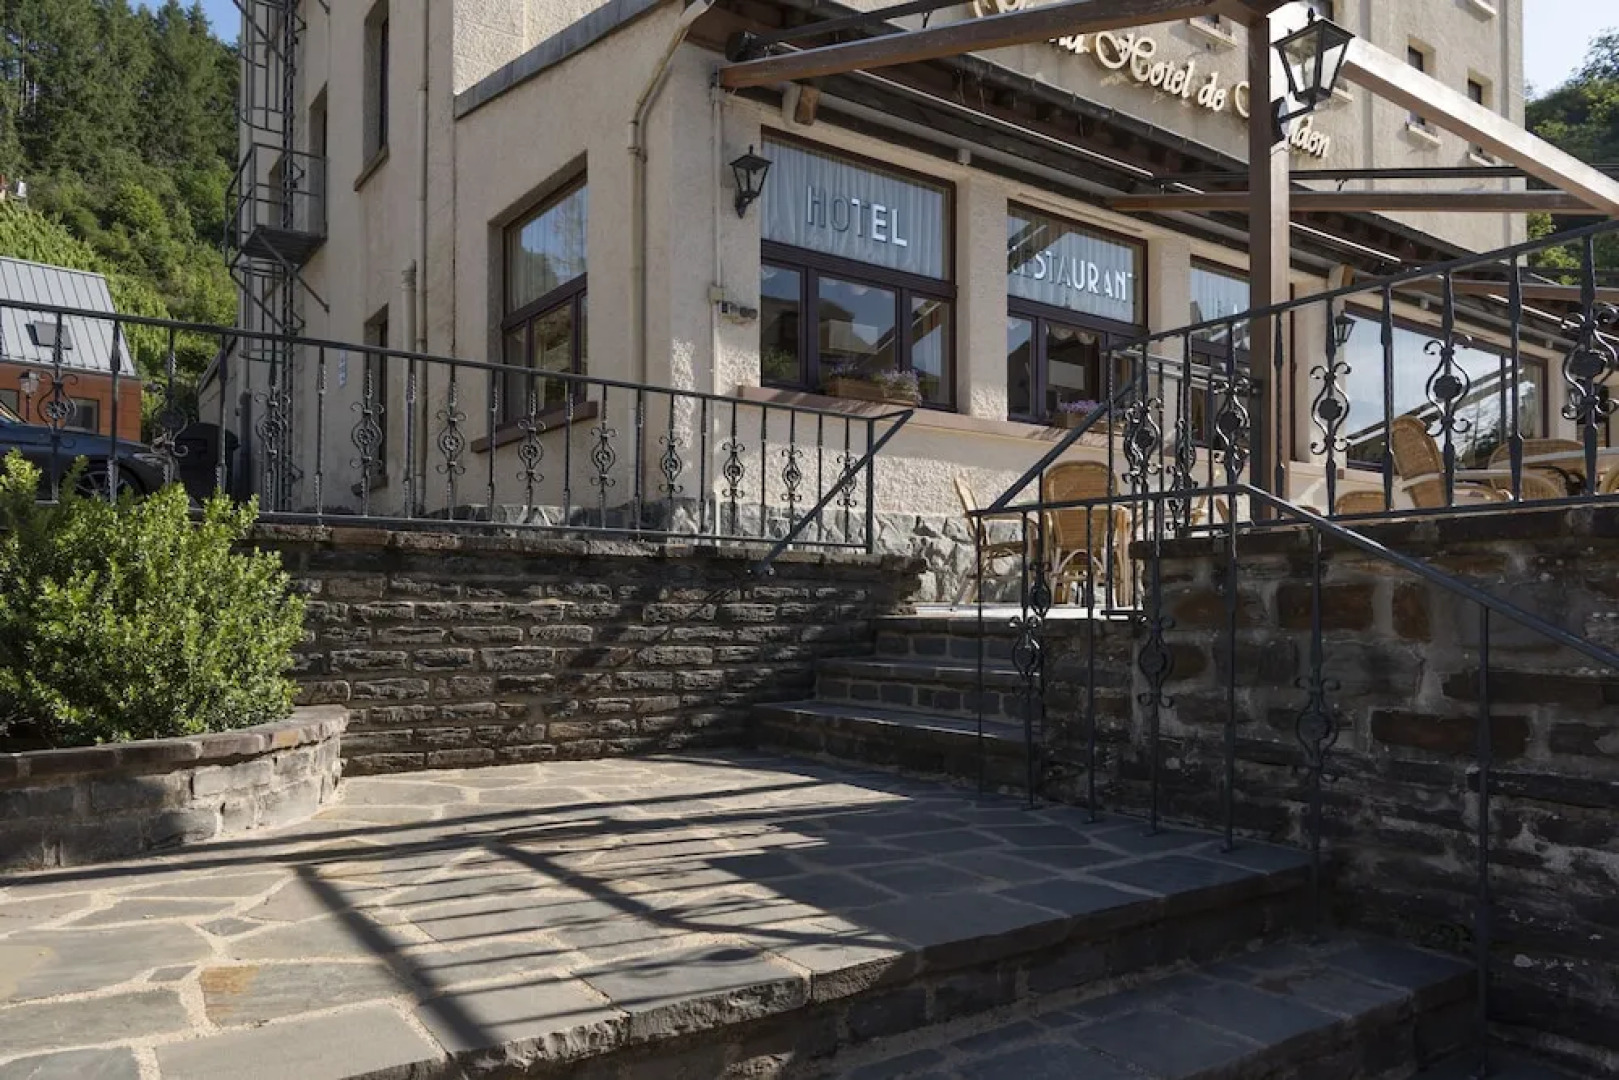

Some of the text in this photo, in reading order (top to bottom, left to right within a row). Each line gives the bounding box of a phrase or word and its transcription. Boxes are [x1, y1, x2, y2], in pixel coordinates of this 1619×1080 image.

[1096, 31, 1196, 98] Hotel
[1198, 72, 1226, 112] de
[807, 185, 908, 247] HOTEL
